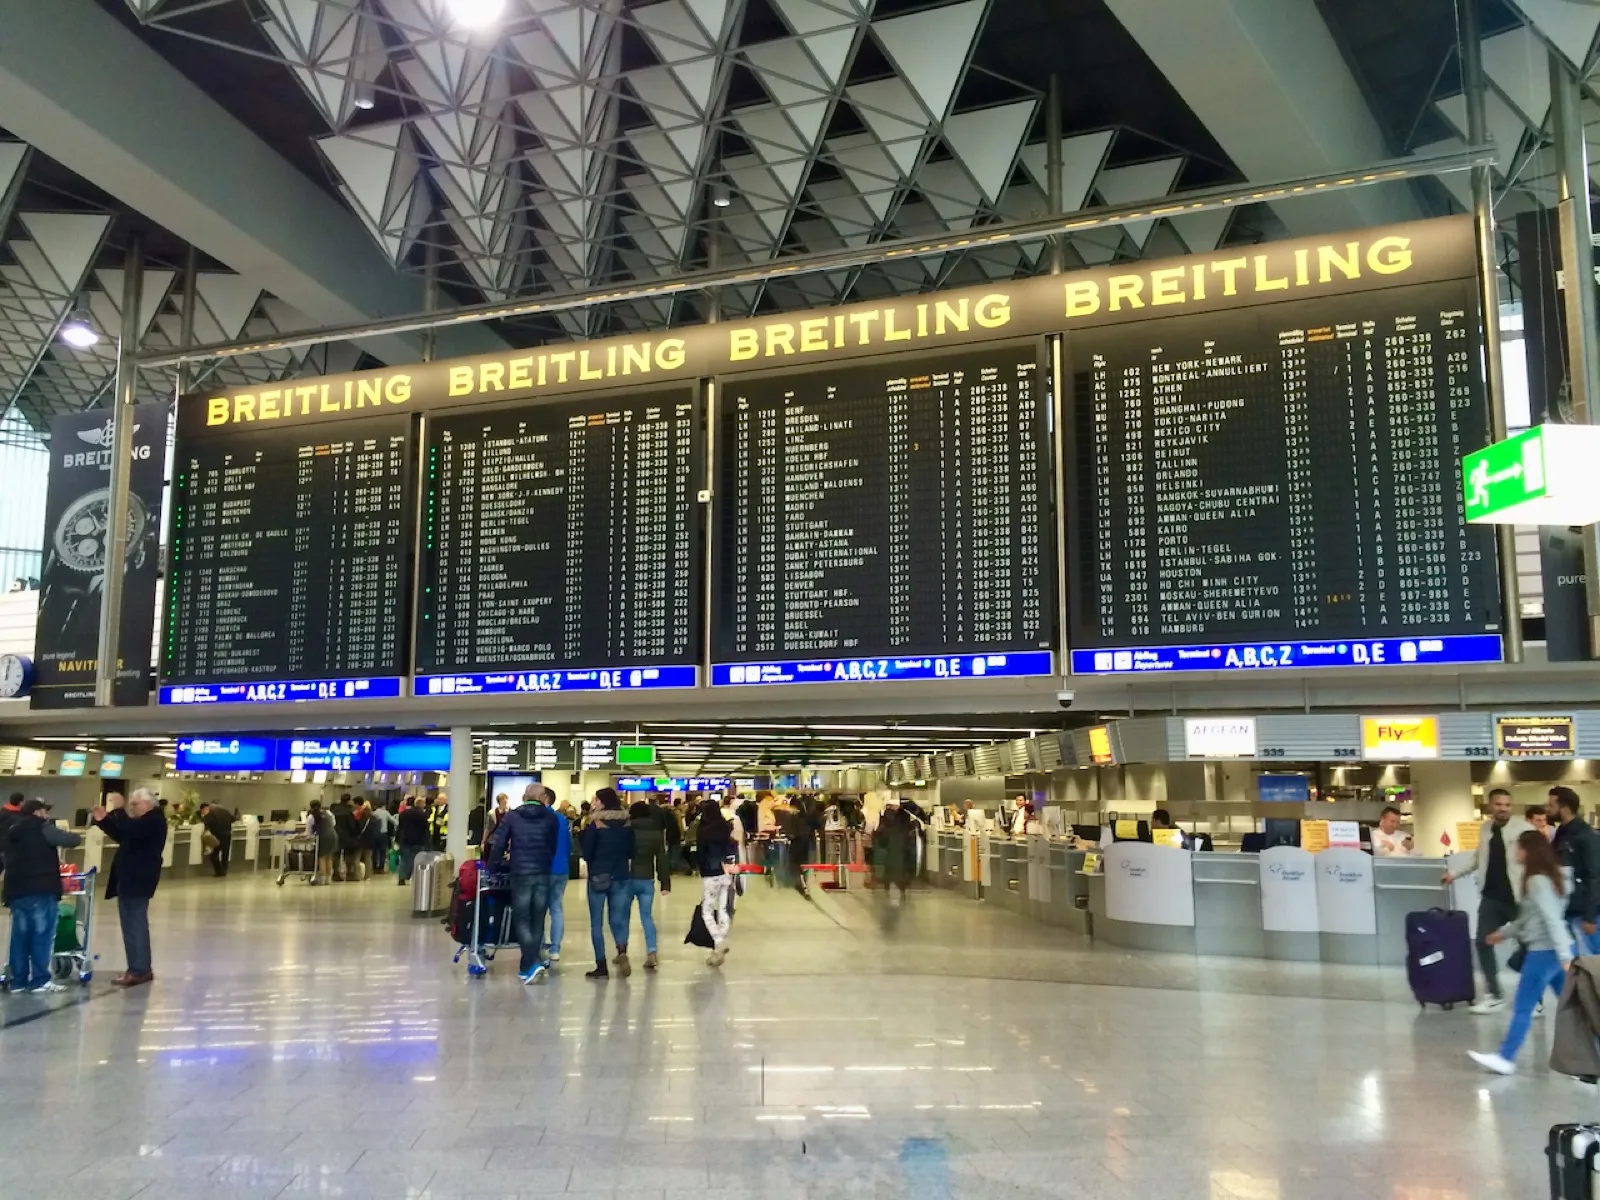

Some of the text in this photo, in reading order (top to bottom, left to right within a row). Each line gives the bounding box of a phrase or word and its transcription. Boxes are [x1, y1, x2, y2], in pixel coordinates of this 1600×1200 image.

[1064, 236, 1413, 318] BREITLING
[729, 293, 1011, 362] BREITLING
[448, 338, 686, 397] BREITLING
[1152, 363, 1169, 373] NEW
[1176, 354, 1244, 371] YORK-NEWARK
[206, 374, 412, 427] BREITLING
[1153, 394, 1181, 406] DELHI
[1153, 398, 1245, 417] SHANGHAI-PUDONG
[1154, 411, 1227, 428] TOKIO-NARITA
[1154, 426, 1190, 439] MEXICO
[1197, 423, 1221, 434] CITY
[1155, 435, 1209, 449] REYKJAVIK
[63, 445, 151, 468] BREITNG
[1155, 448, 1191, 460] BEIRUT
[1156, 470, 1198, 482] ORLANDO
[1393, 472, 1441, 485] 741-747
[1156, 480, 1203, 493] HELSINKI
[1157, 500, 1230, 514] NAGOYA-CHUBU
[1231, 509, 1256, 520] ALIA
[1158, 525, 1187, 536] KAIRO
[1158, 536, 1188, 547] PORTO
[1158, 544, 1231, 558] BERLIN-TEGEL
[1159, 568, 1201, 580] HOUSTON
[1399, 554, 1446, 566] 501-506
[1159, 581, 1171, 590] HO
[1178, 580, 1194, 589] CHI
[1233, 576, 1258, 586] CITY
[1557, 575, 1586, 587] pure
[1234, 598, 1259, 608] ALIA
[1161, 613, 1178, 623] TEL
[1185, 611, 1234, 622] AVIV-BEN
[1241, 609, 1278, 619] GURION
[1161, 623, 1203, 634] HAMBURG
[58, 658, 124, 672] NAVITIR
[1263, 748, 1285, 757] 535
[1465, 747, 1489, 756] 533
